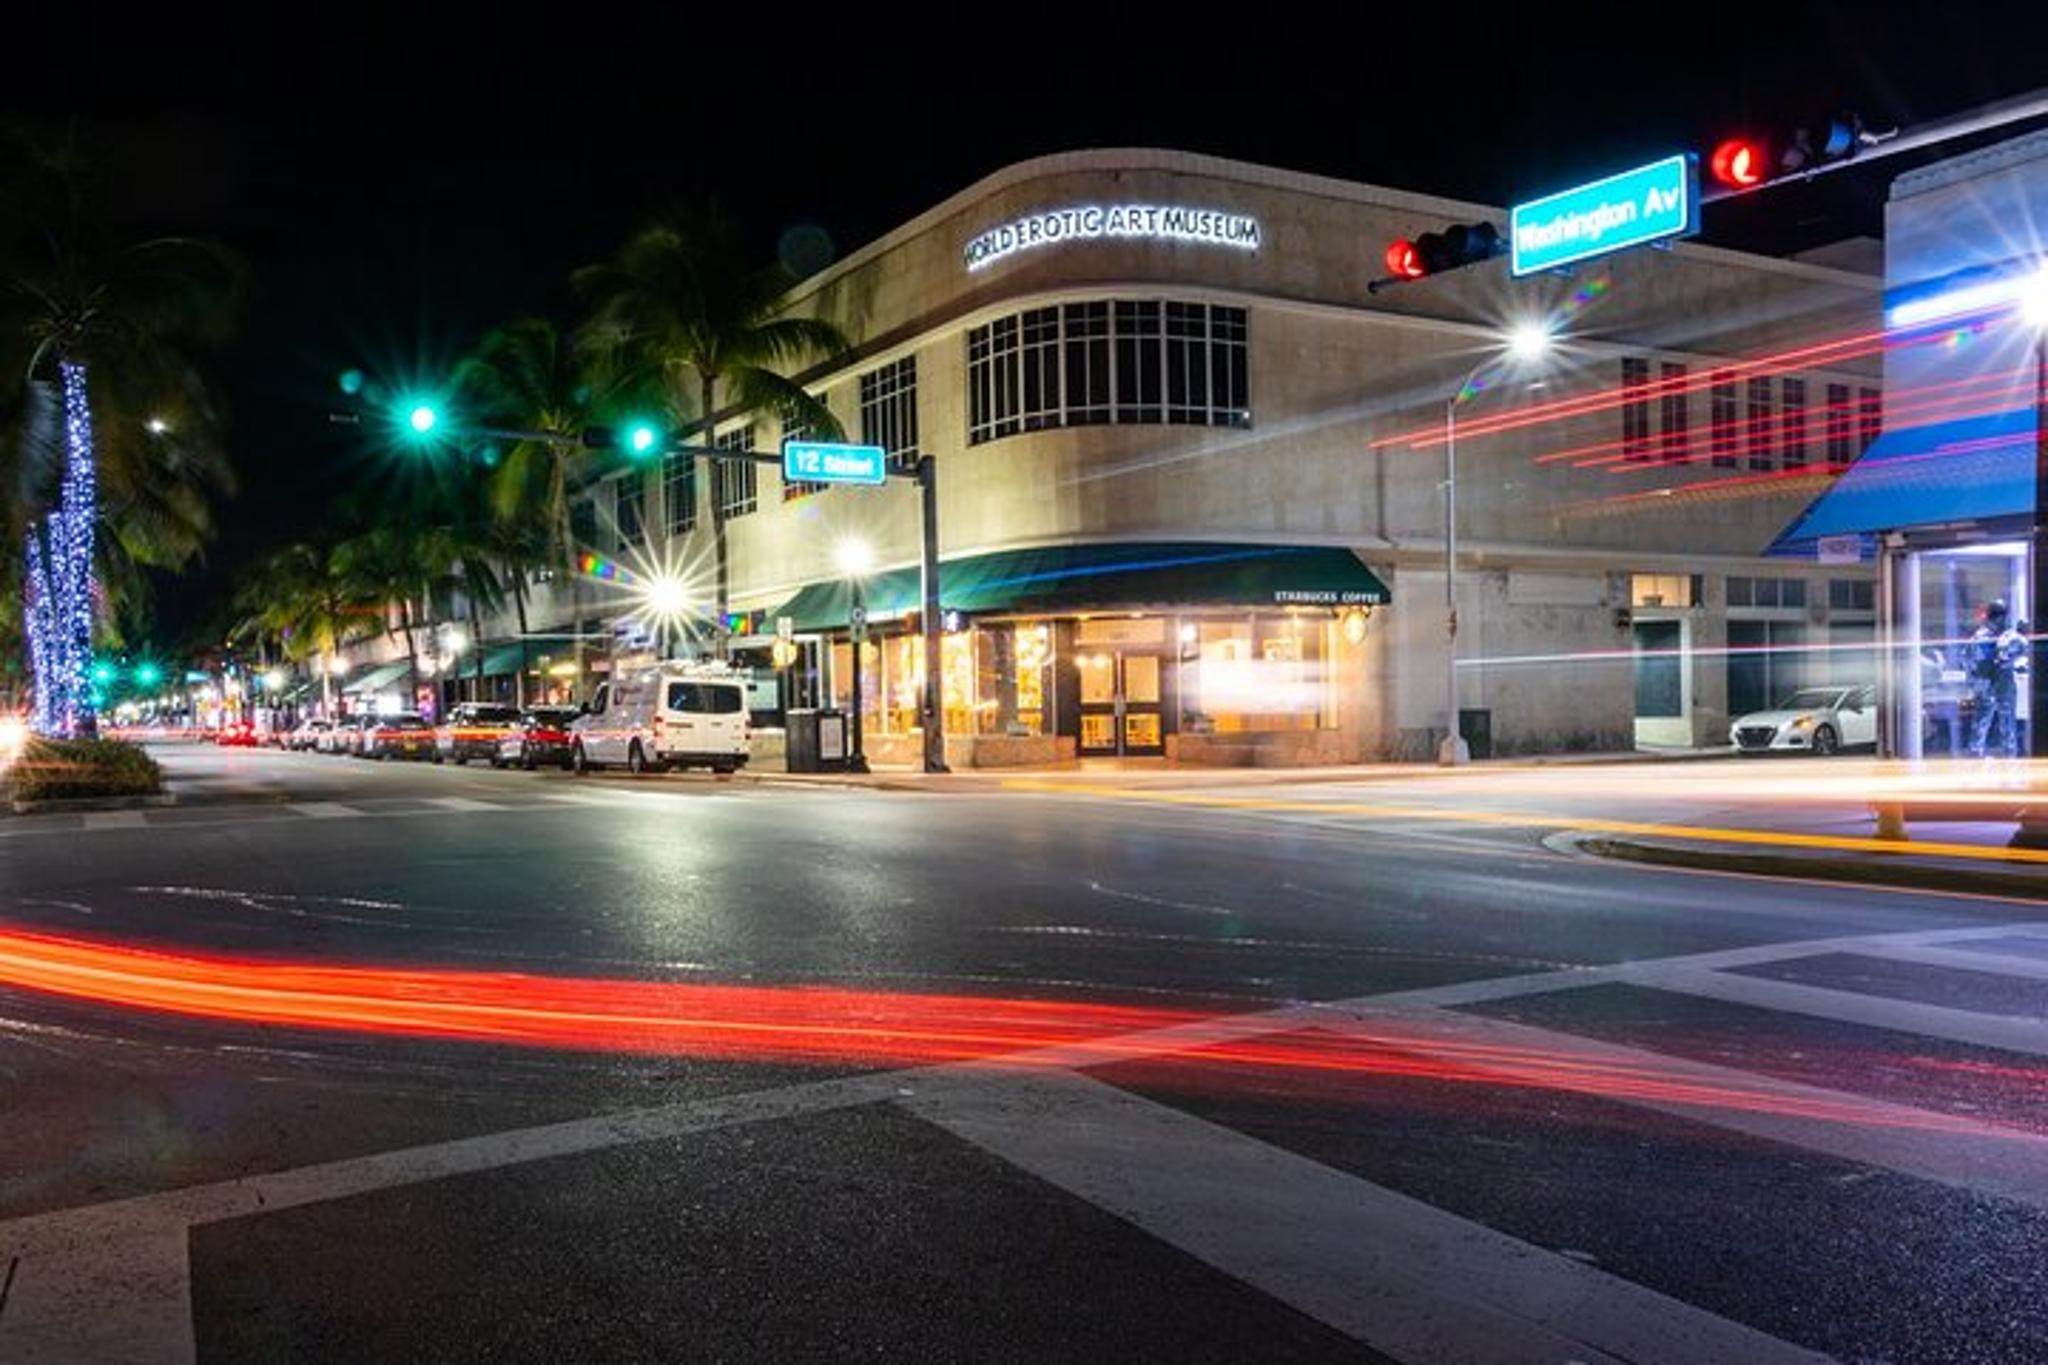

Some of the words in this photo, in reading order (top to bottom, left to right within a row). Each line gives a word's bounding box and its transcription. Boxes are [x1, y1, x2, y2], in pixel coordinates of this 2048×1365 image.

[1644, 186, 1679, 218] Av
[1016, 208, 1100, 246] EROTIC
[1107, 207, 1156, 232] ART
[1161, 209, 1259, 245] MUSEUM
[796, 450, 820, 473] 12
[1274, 591, 1338, 603] STARBUCKS
[1341, 591, 1380, 603] COFFEE
